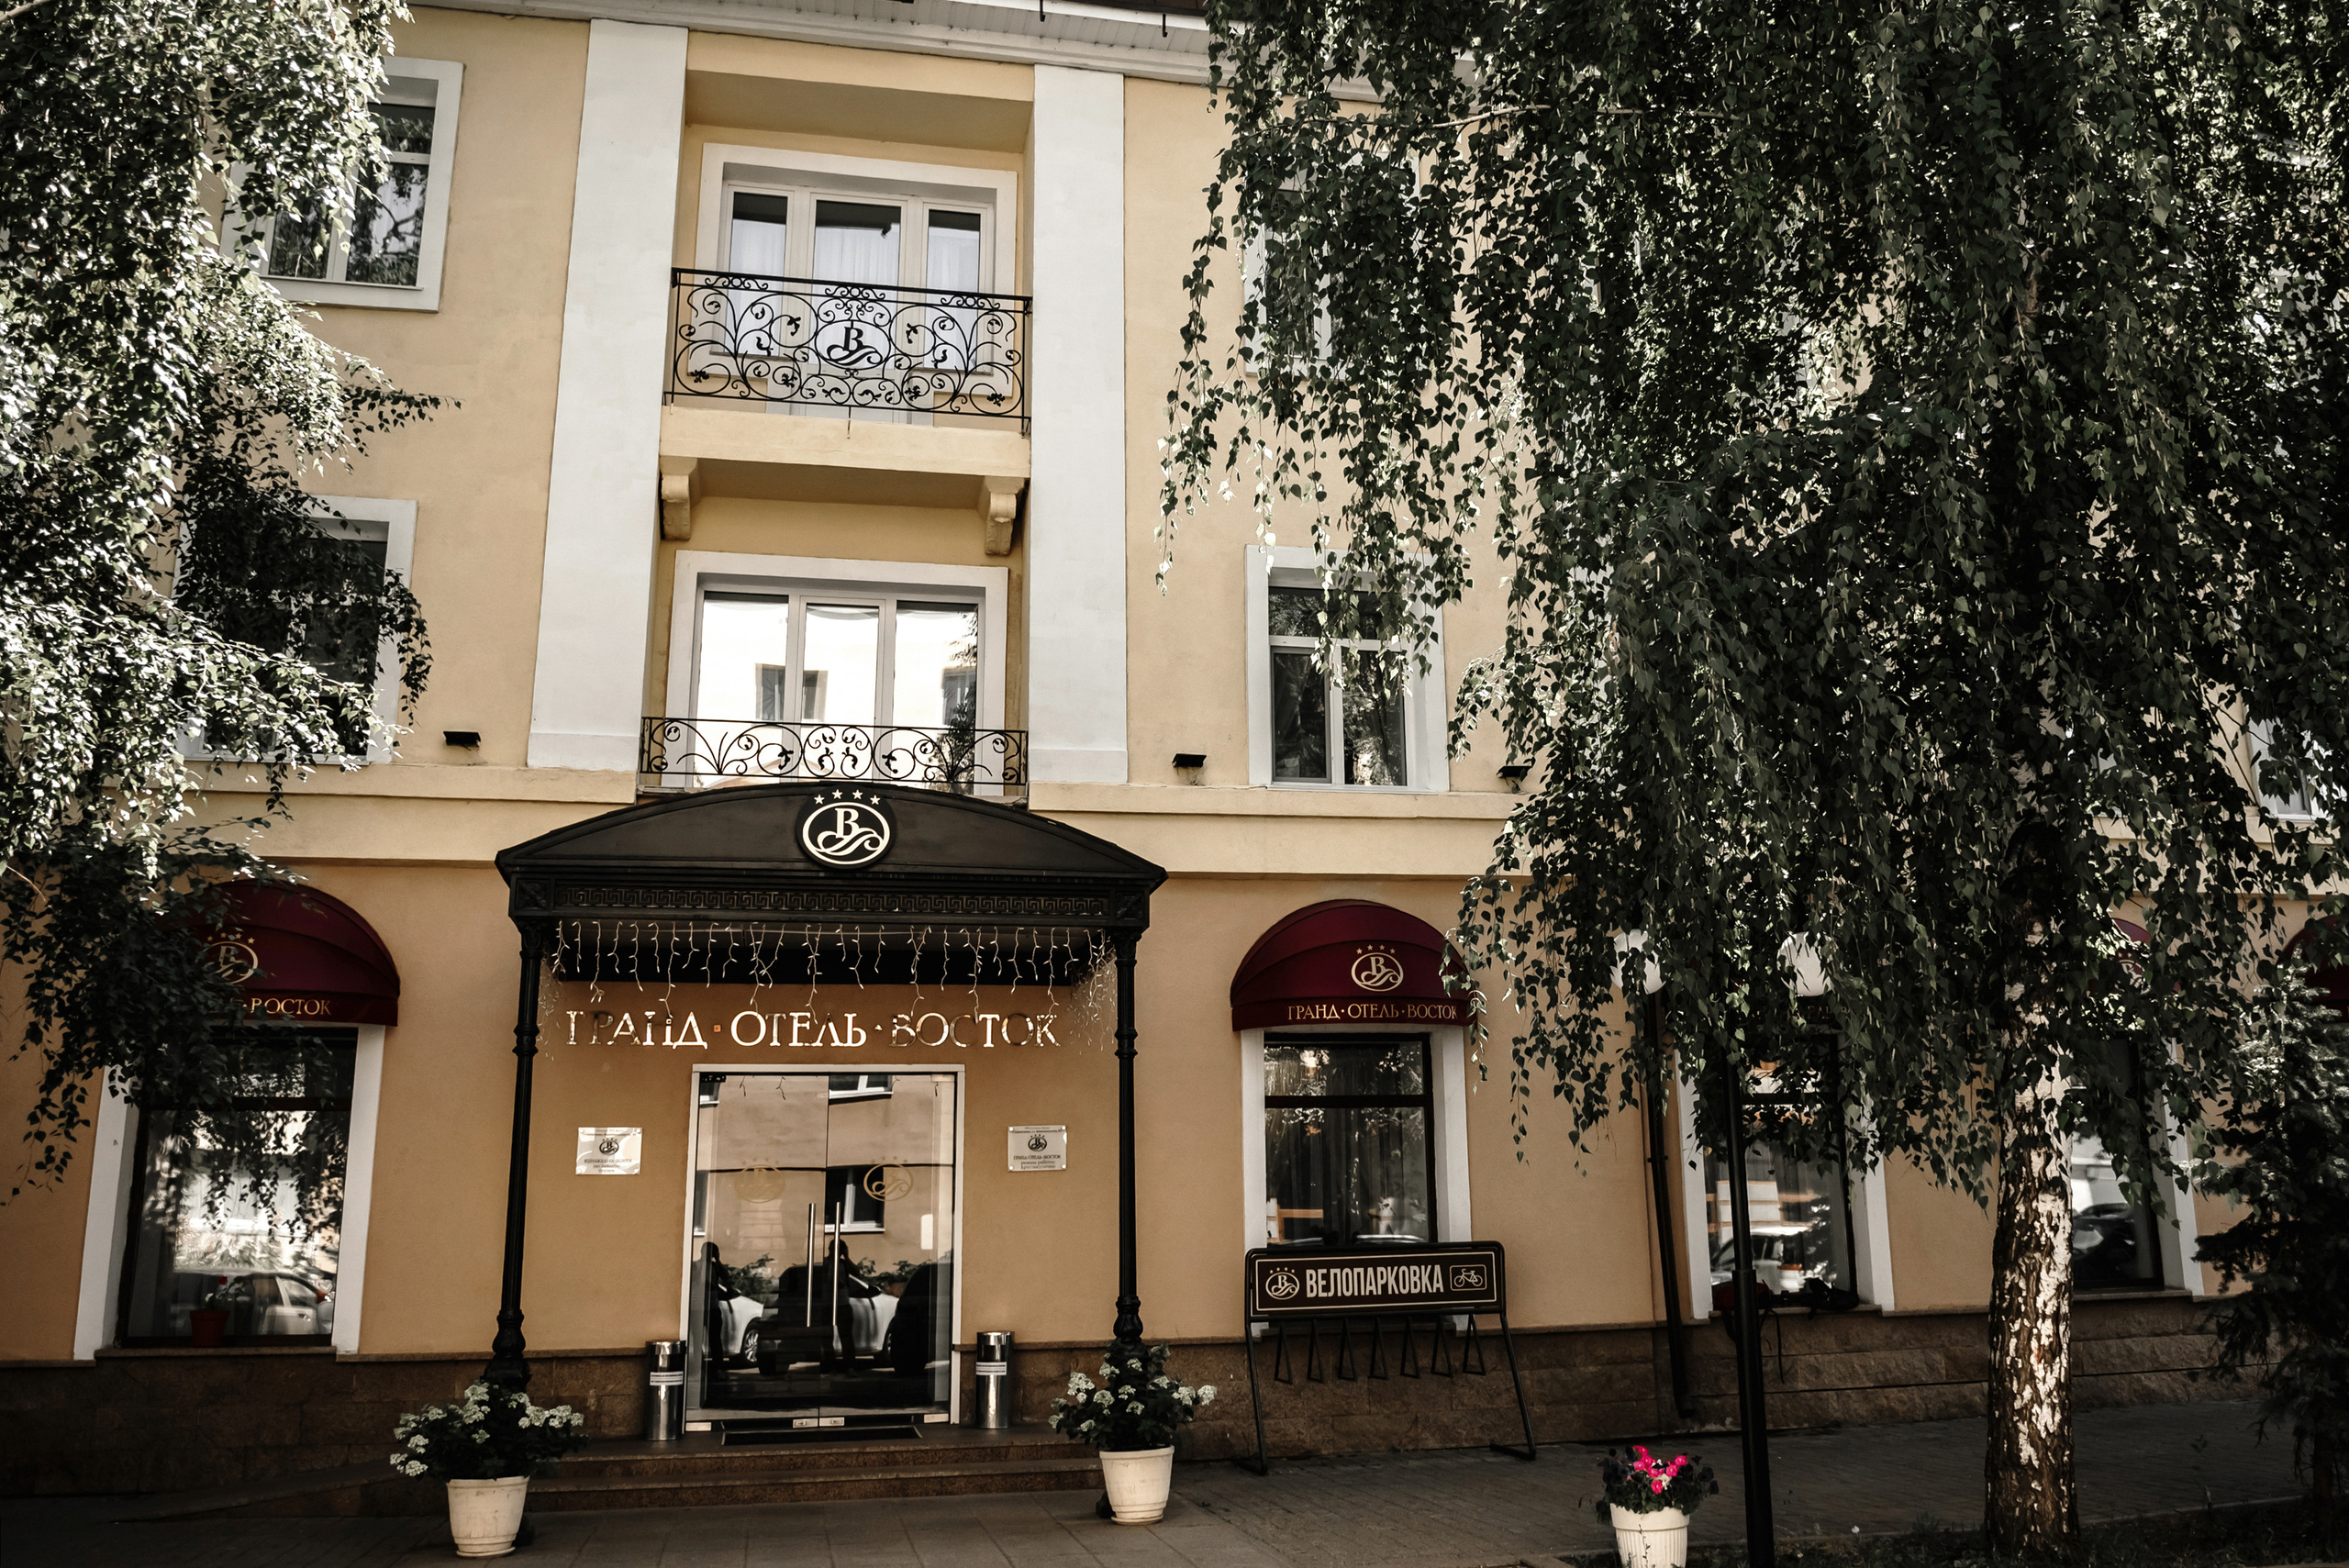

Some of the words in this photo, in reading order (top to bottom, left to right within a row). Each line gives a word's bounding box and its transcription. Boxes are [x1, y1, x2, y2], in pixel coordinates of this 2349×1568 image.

[1287, 1004, 1341, 1020] ГРАНД
[1347, 1003, 1400, 1019] ОТЕЛЬ
[1407, 1004, 1459, 1020] ВОСТОК
[565, 1010, 708, 1050] ГРАНД
[730, 1010, 868, 1048] ОТЕЛЬ
[888, 1012, 1062, 1048] ВОСТОК
[1306, 1264, 1444, 1298] ВЕЛОПАРКОВКА
